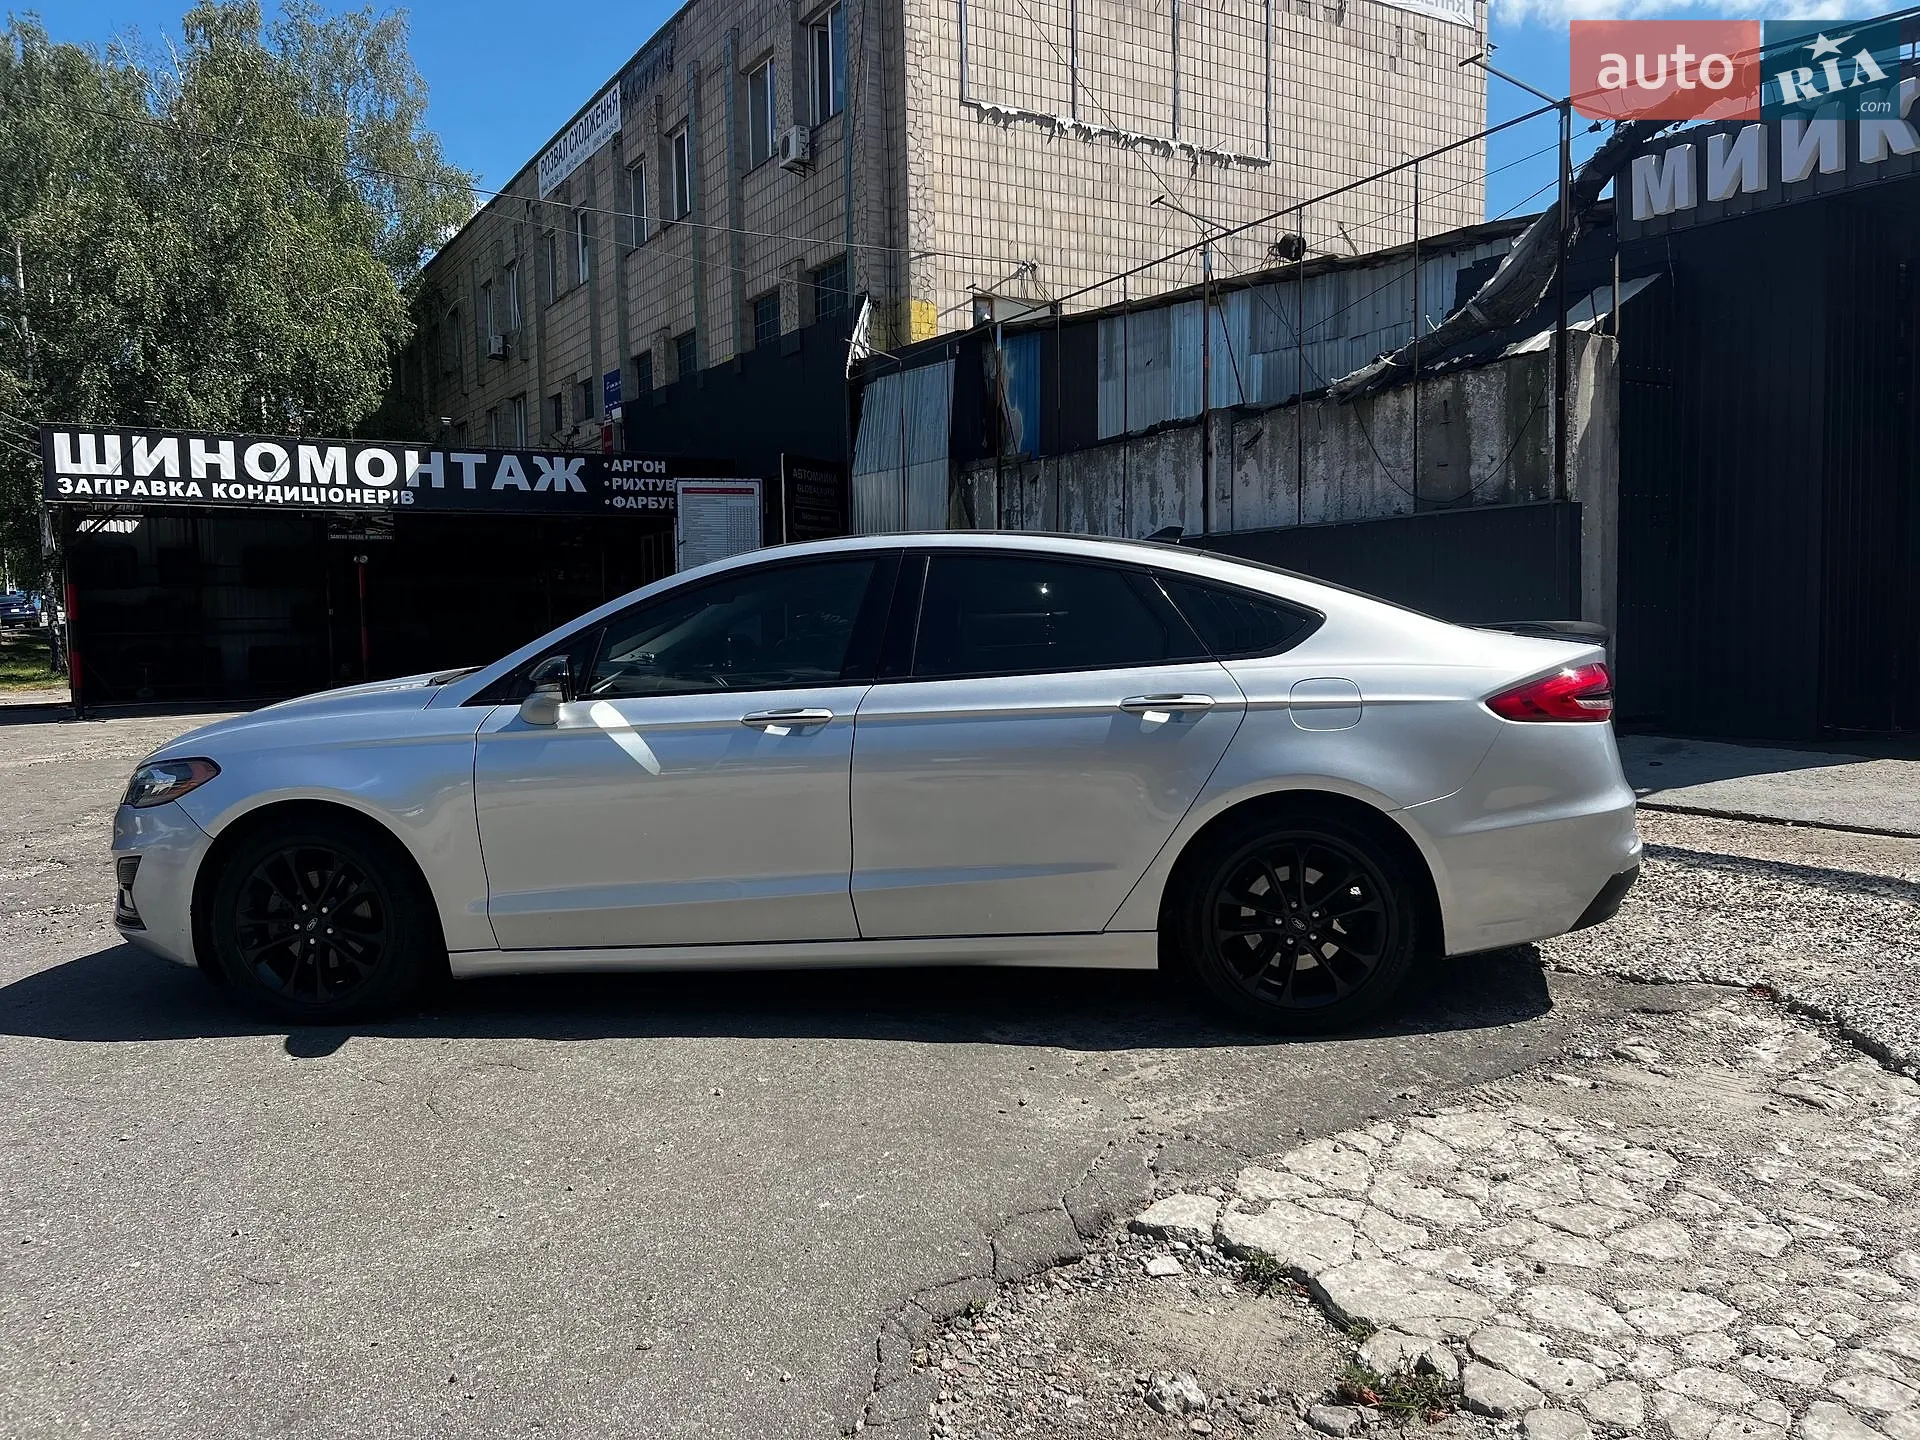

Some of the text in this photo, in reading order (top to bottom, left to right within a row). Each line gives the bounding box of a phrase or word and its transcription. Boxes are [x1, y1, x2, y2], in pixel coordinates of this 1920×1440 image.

[541, 137, 568, 178] РОЗВАЛ
[569, 88, 618, 154] СХОДЖЕННЯ
[52, 432, 587, 493] ШИНОМОНТАЖ
[611, 459, 666, 473] АРГОН
[57, 477, 415, 505] ЗАПРАВКА КОНДИЦІОНЕРІВ
